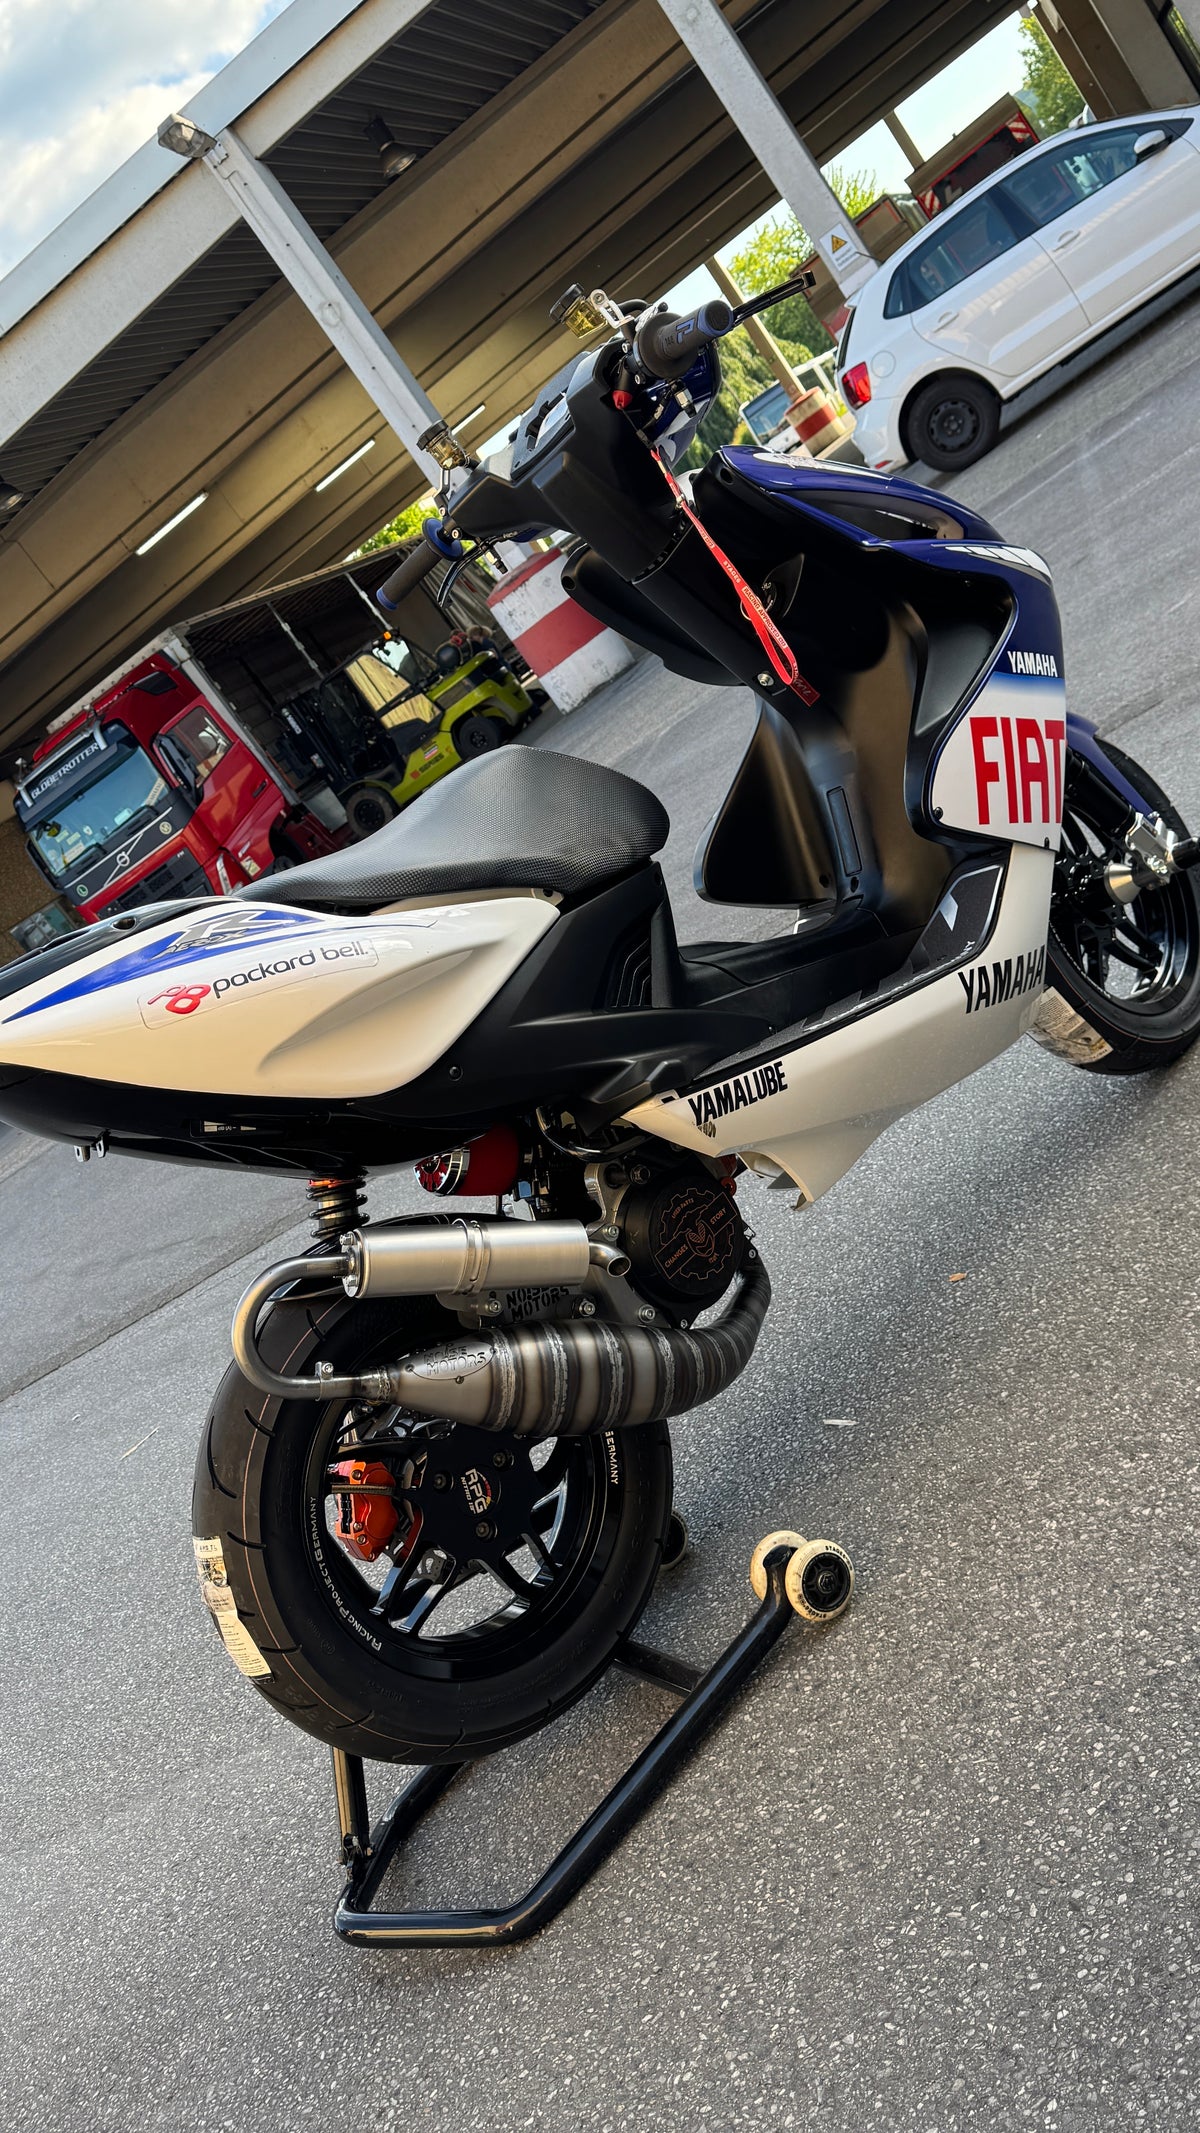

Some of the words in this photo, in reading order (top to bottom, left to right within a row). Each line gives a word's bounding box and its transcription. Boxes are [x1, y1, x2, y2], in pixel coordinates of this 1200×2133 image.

[1007, 651, 1059, 678] YAMAHA
[30, 742, 99, 800] GLOBETROTTER
[969, 716, 1066, 826] FIAT
[212, 948, 317, 999] packard
[957, 944, 1047, 1015] YAMAHA
[687, 1060, 788, 1127] YAMALUBE
[709, 1207, 727, 1225] STORY
[664, 1243, 689, 1269] CHANGES
[510, 1286, 570, 1322] MOTORS
[426, 1351, 487, 1376] MOTORS
[460, 1476, 473, 1500] NITRO
[465, 1467, 488, 1514] RPG
